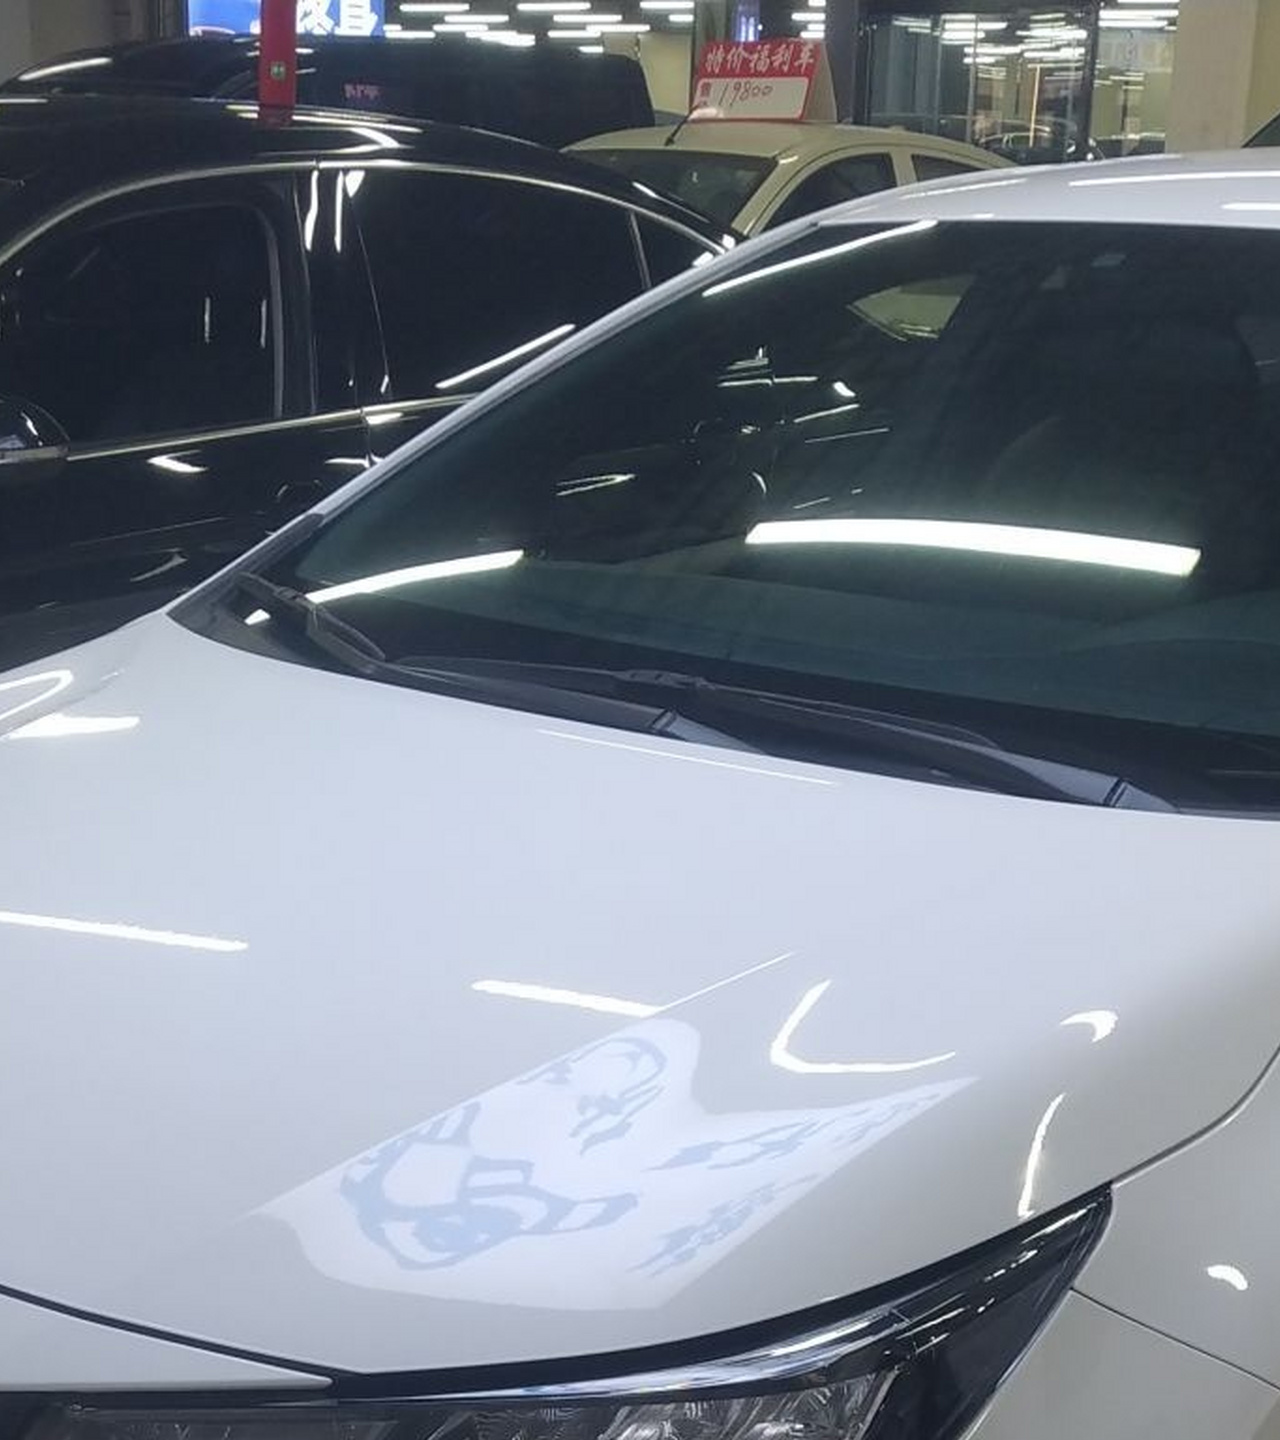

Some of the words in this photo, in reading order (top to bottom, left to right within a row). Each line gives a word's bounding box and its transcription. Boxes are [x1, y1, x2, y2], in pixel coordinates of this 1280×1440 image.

[705, 42, 816, 75] 特价福利车
[719, 80, 773, 108] 19800
